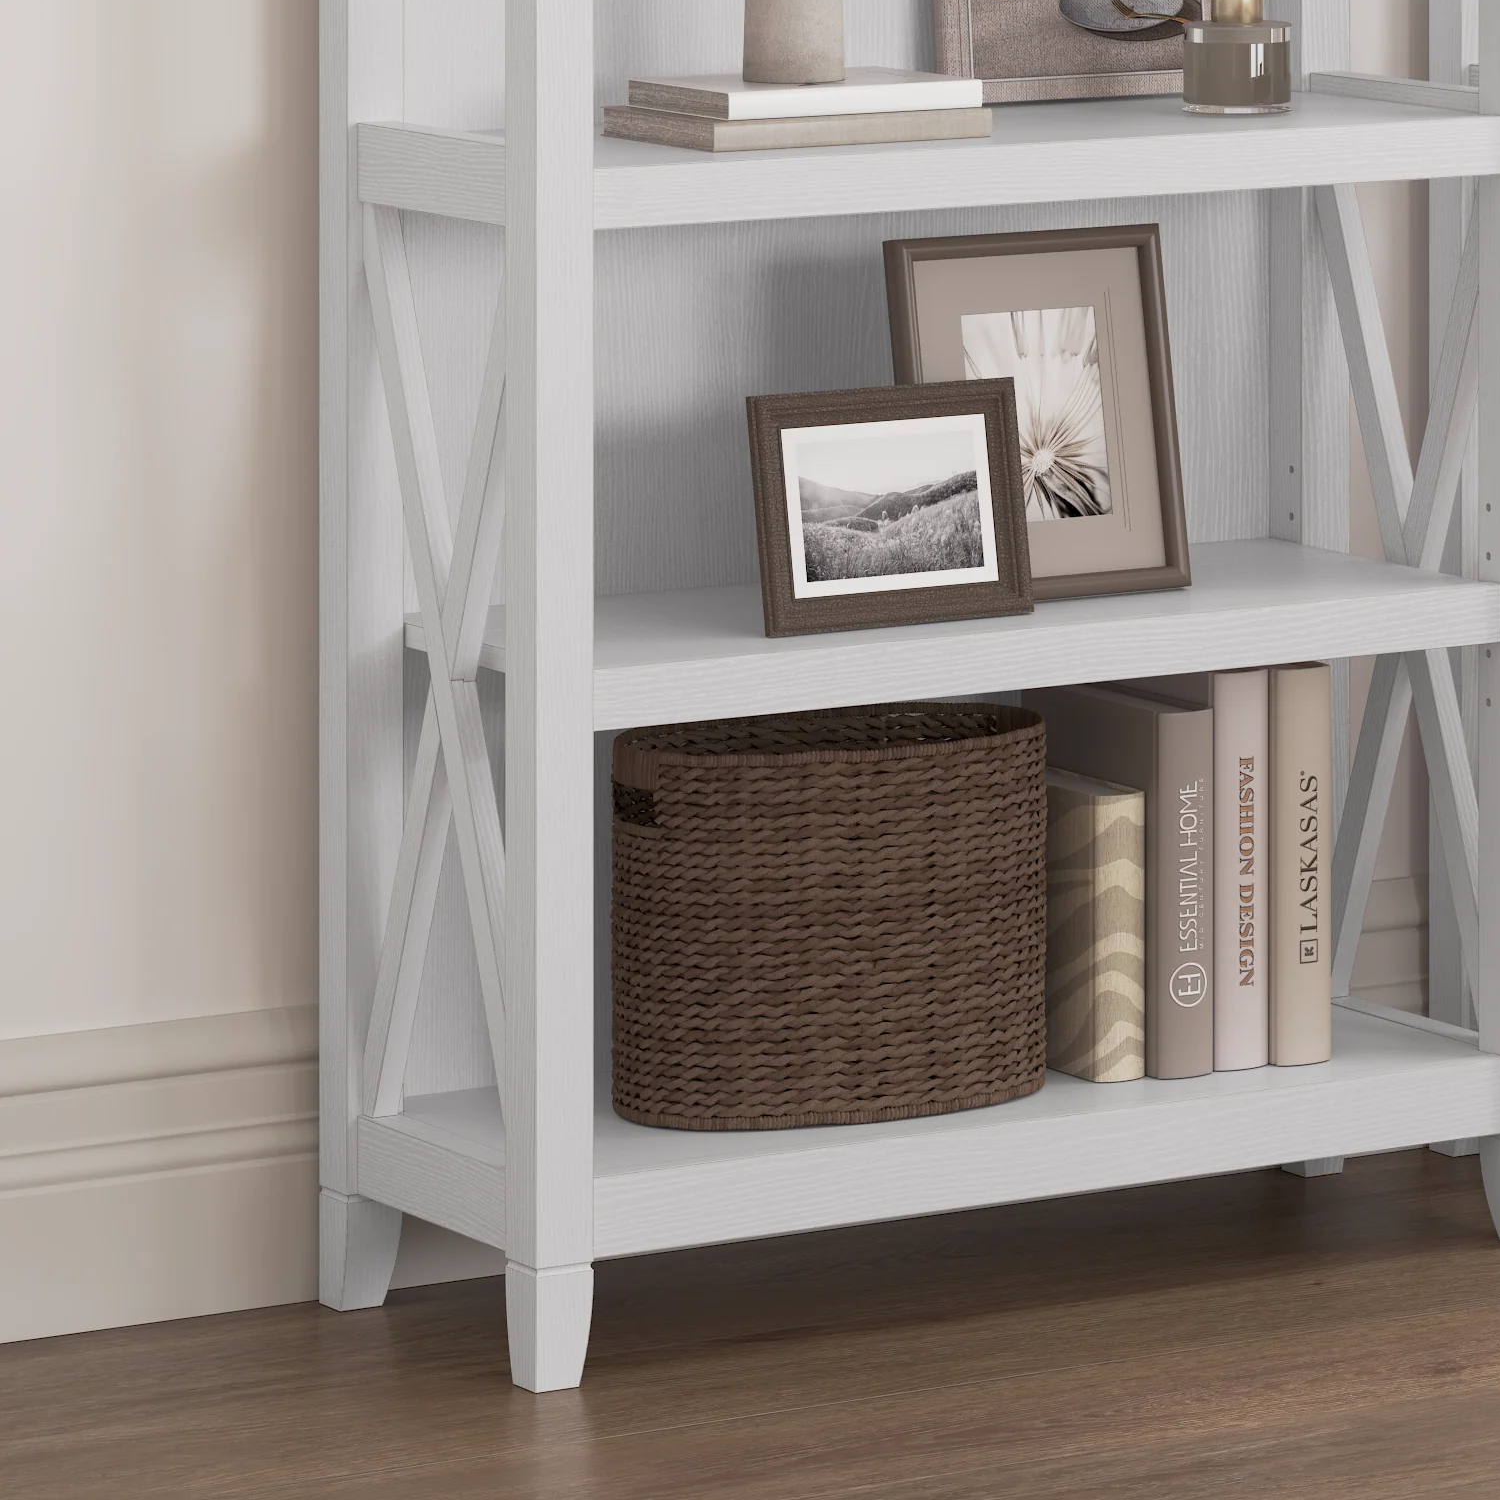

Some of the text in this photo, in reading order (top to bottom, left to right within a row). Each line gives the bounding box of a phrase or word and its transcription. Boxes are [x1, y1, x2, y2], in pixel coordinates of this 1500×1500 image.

[1179, 780, 1198, 952] ESSENTIAL HOME
[1238, 755, 1255, 987] FASHION DESIGN
